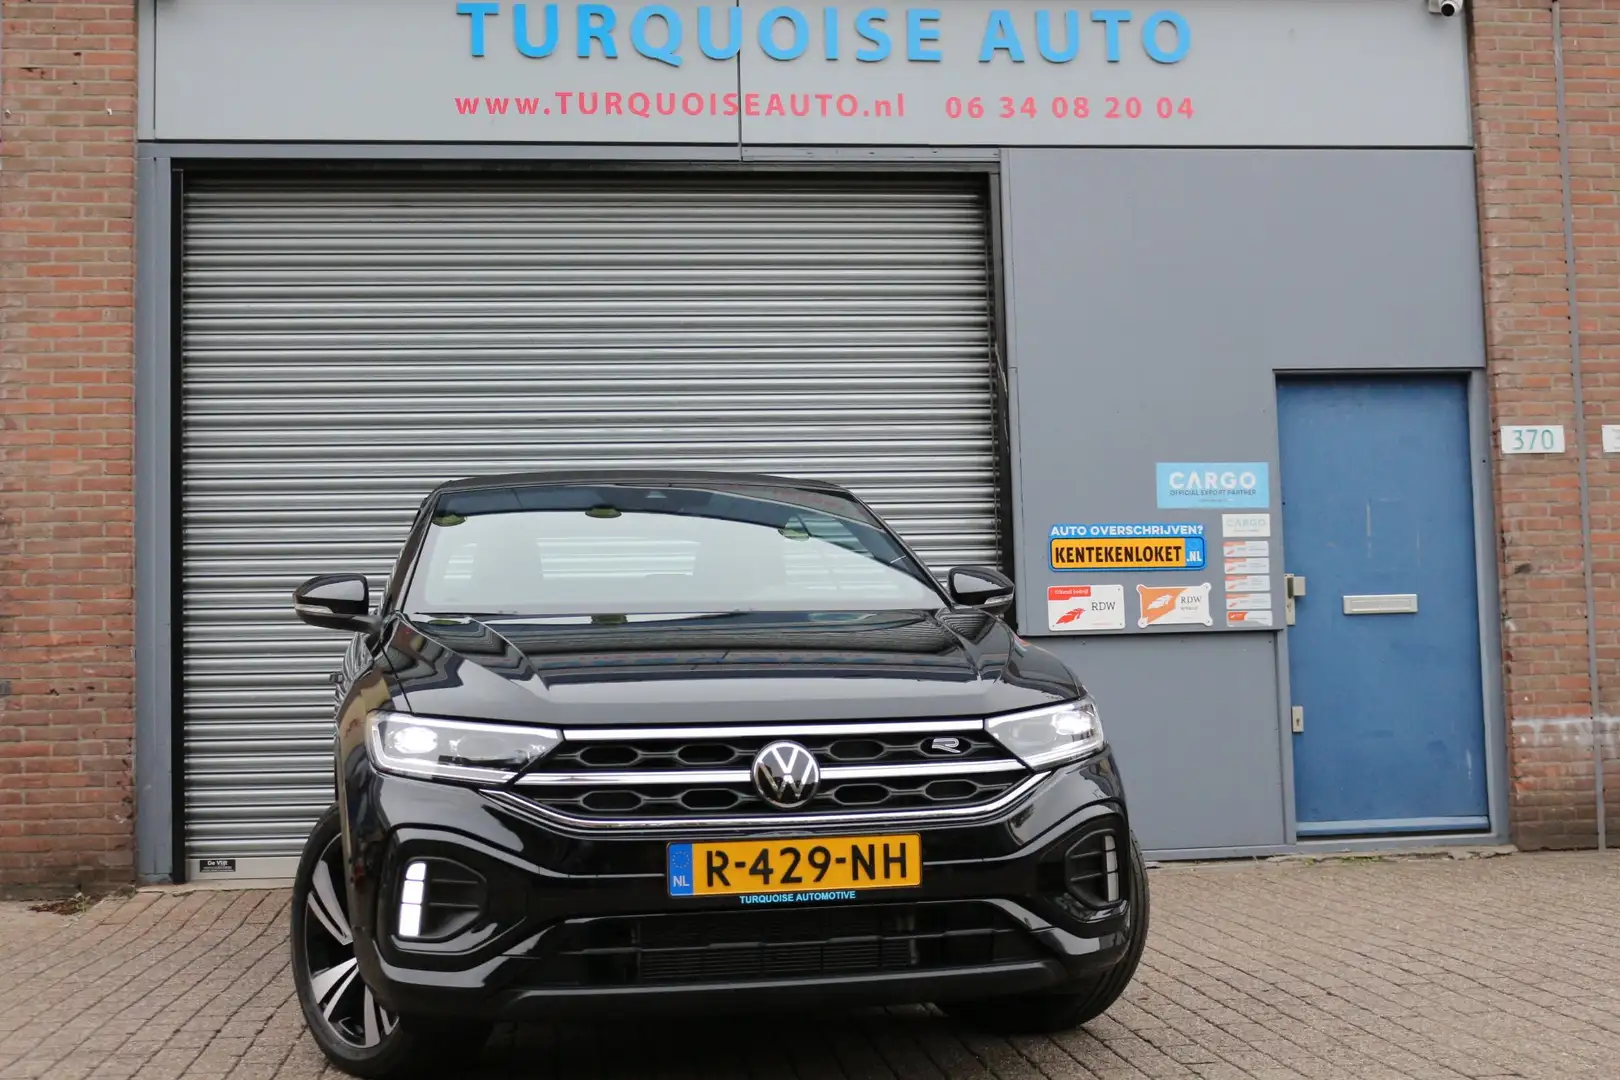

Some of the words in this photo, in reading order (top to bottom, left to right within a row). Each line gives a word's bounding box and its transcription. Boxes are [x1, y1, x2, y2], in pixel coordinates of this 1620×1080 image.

[456, 1, 943, 67] TURQUOISE
[978, 9, 1192, 64] AUTO
[454, 91, 905, 119] www.TURQUOISEAUTO.nl
[945, 96, 985, 119] 06
[999, 96, 1038, 119] 34
[1051, 96, 1091, 119] 08
[1104, 96, 1143, 119] 20
[1156, 96, 1195, 119] 04
[1512, 428, 1554, 451] 370
[1169, 471, 1256, 489] CARGO
[1169, 488, 1199, 496] OFFICIAL
[1201, 488, 1226, 496] EXPORT
[1228, 488, 1256, 496] PARTNER
[1050, 526, 1087, 537] AUTO
[1090, 525, 1204, 536] OVERSCHRIJVEN?
[1091, 601, 1116, 611] RDW
[1181, 596, 1202, 604] RDW
[673, 876, 689, 887] NL
[706, 843, 907, 887] R-429-NH
[740, 893, 794, 904] TURQUOISE
[795, 891, 856, 902] AUTOMOTIVE
